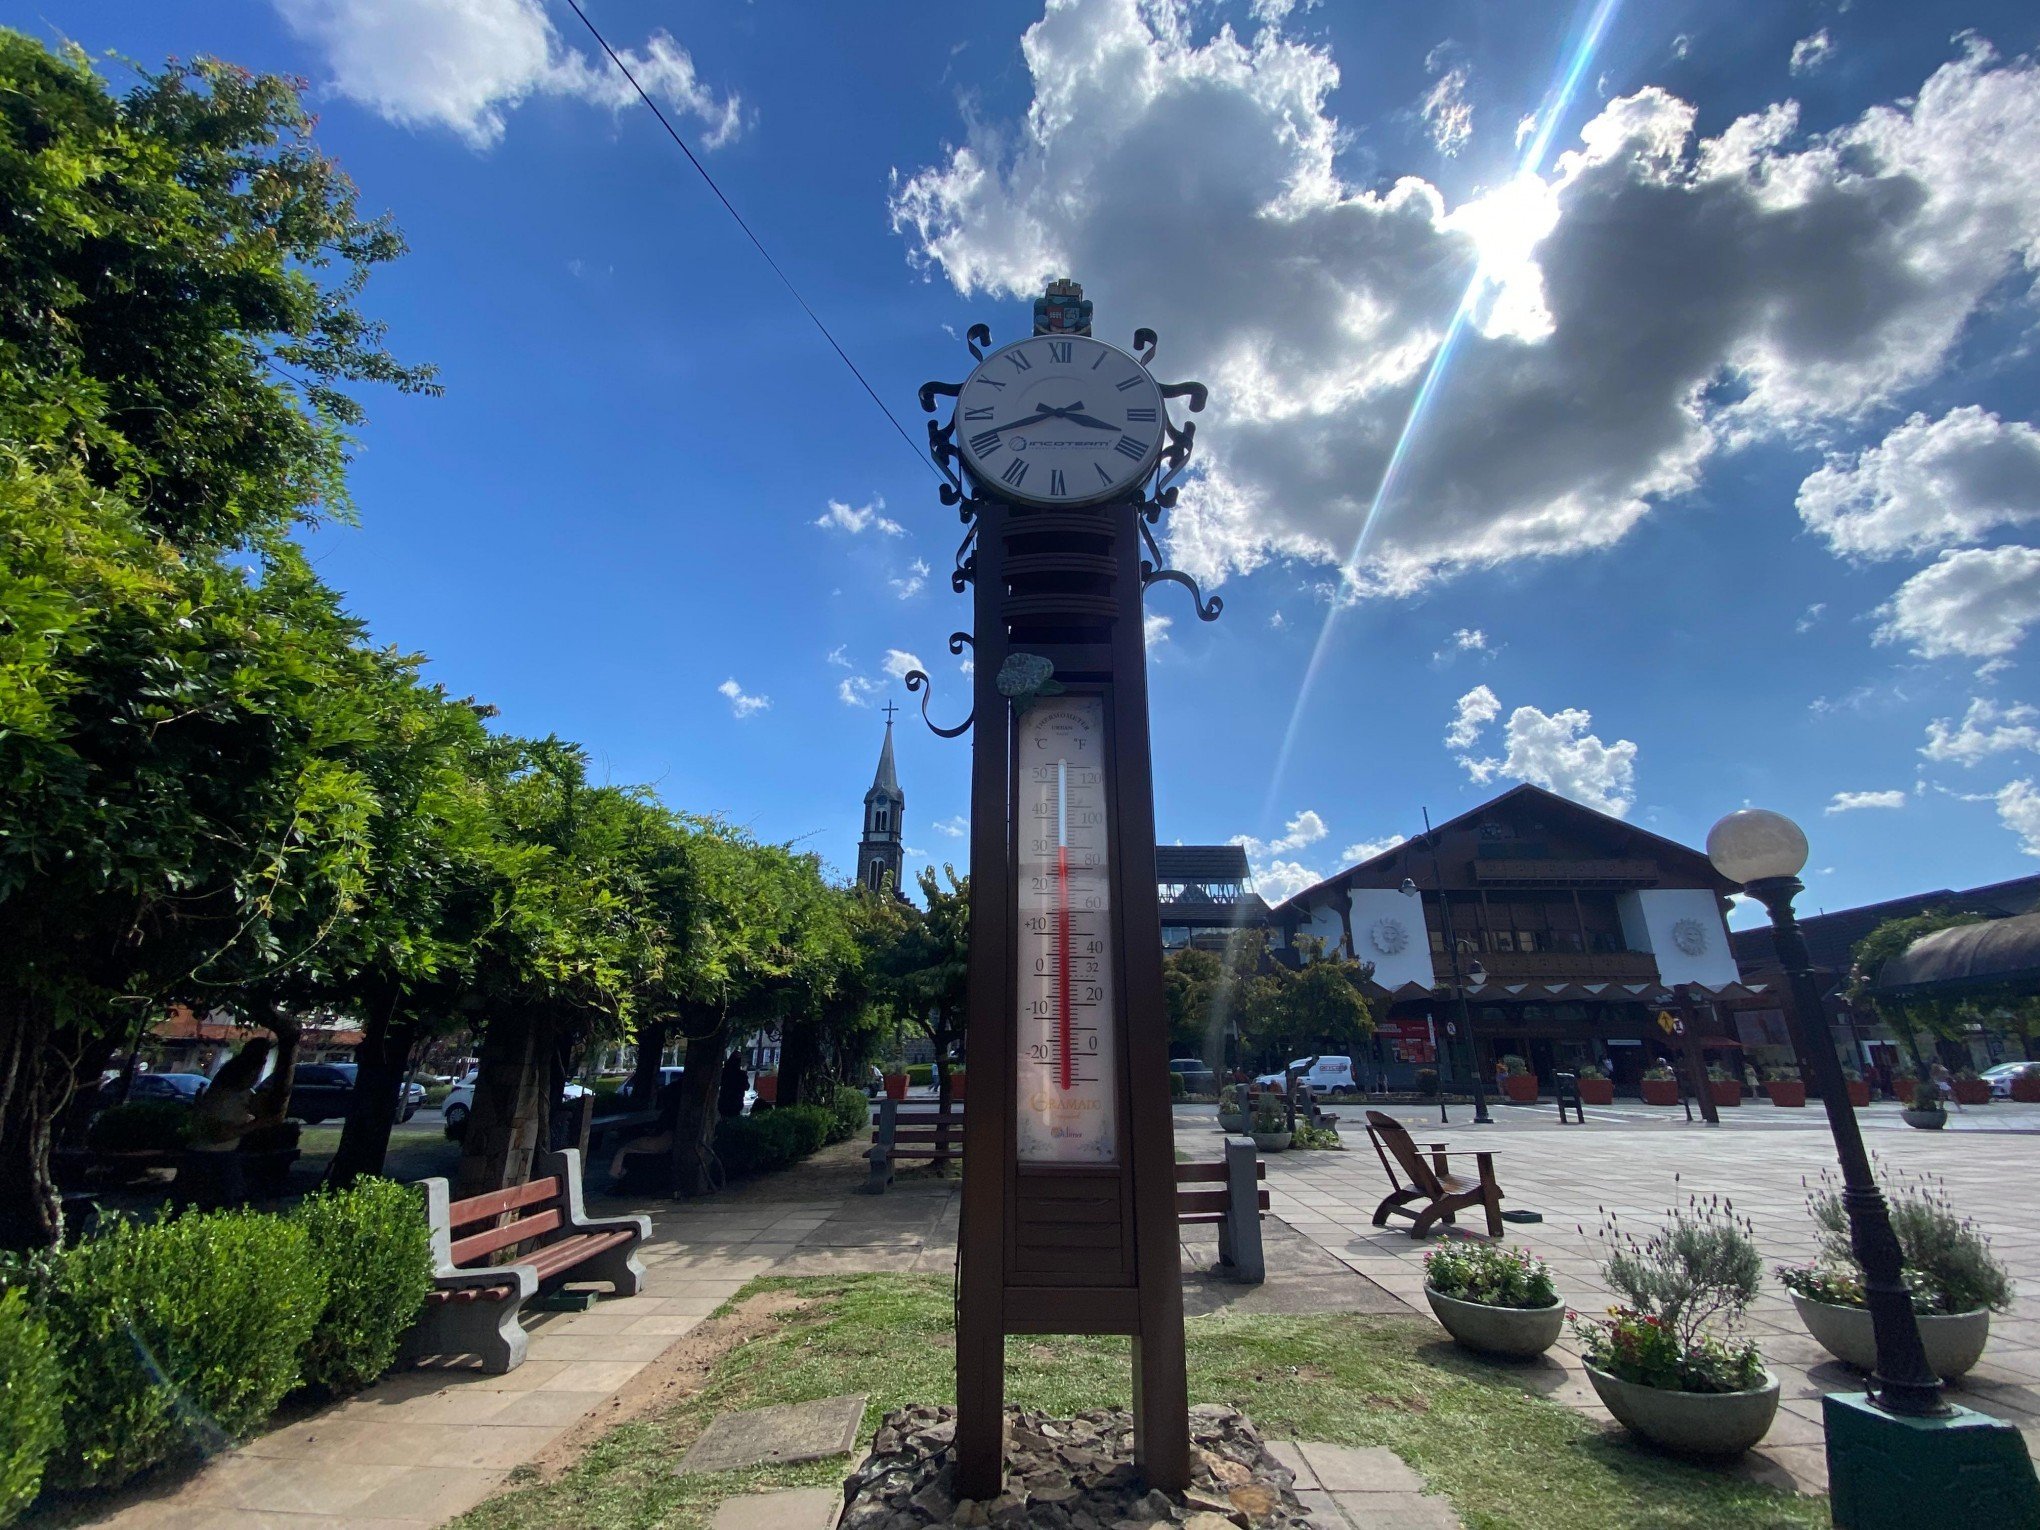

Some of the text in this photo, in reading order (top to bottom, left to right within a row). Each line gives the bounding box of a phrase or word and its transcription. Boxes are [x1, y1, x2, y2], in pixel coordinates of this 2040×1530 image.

[1050, 342, 1072, 363] XII
[1004, 350, 1031, 374] XI
[976, 375, 1006, 391] X
[1116, 375, 1144, 392] II
[965, 407, 994, 421] IX
[1127, 409, 1156, 422] III
[1094, 463, 1114, 487] V
[1051, 470, 1067, 496] VI
[1036, 712, 1090, 731] THERMOMETER
[1032, 767, 1048, 779] 50
[1081, 773, 1102, 784] 120
[1032, 803, 1048, 815] 40
[1082, 813, 1103, 825] 100
[1032, 840, 1048, 852] 30
[1085, 854, 1100, 866] 80
[1032, 878, 1048, 890] 20
[1085, 896, 1101, 909] 60
[1024, 917, 1047, 930] +10
[1087, 941, 1103, 954] 40
[1035, 958, 1044, 972] 0
[1087, 963, 1099, 973] 32
[1086, 987, 1103, 1001] 20
[1025, 1001, 1048, 1014] -10
[1089, 1036, 1097, 1050] 0
[1025, 1045, 1048, 1059] -20
